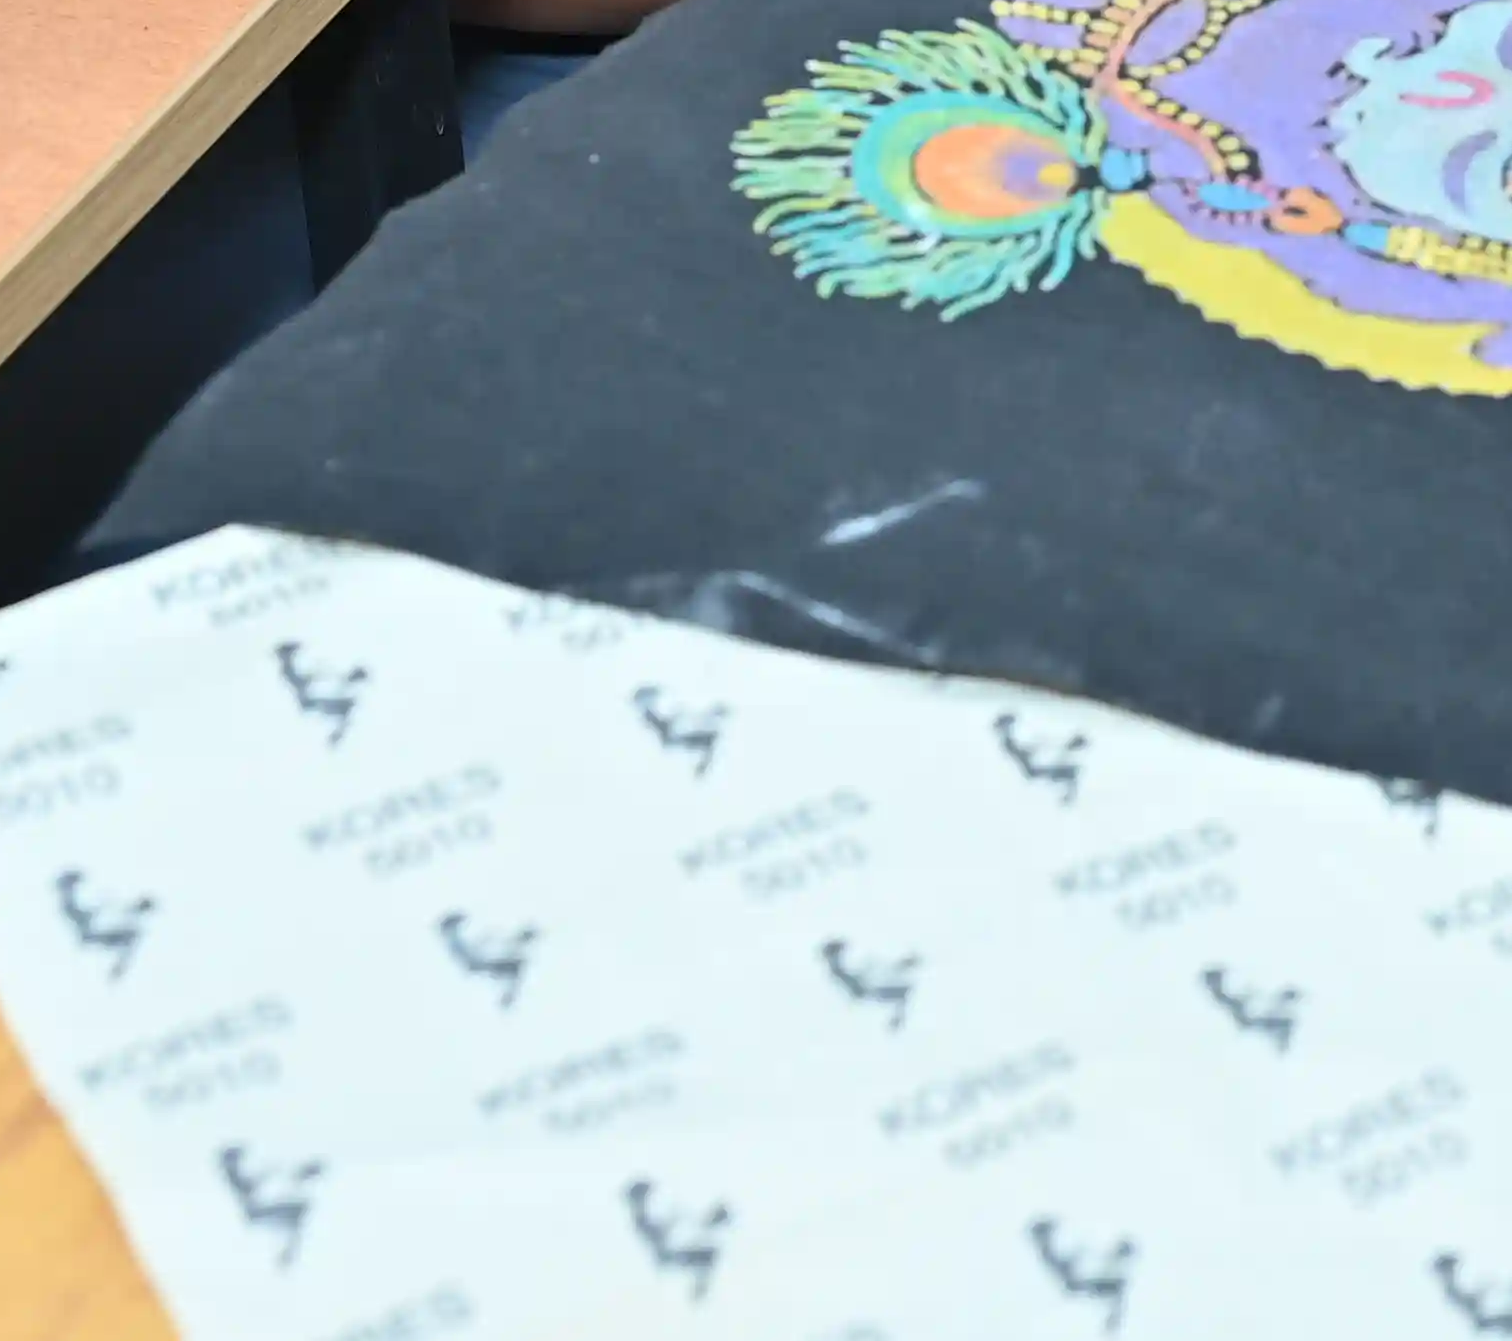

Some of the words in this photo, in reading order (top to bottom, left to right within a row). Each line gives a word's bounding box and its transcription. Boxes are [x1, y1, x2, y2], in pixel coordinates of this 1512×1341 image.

[305, 761, 502, 852] KORES
[679, 786, 869, 874] KORES
[1055, 820, 1236, 896] KORES
[79, 997, 292, 1091] KORES
[477, 1027, 684, 1115] KORES
[878, 1038, 1076, 1136] KORES
[1269, 1068, 1467, 1174] KORES
